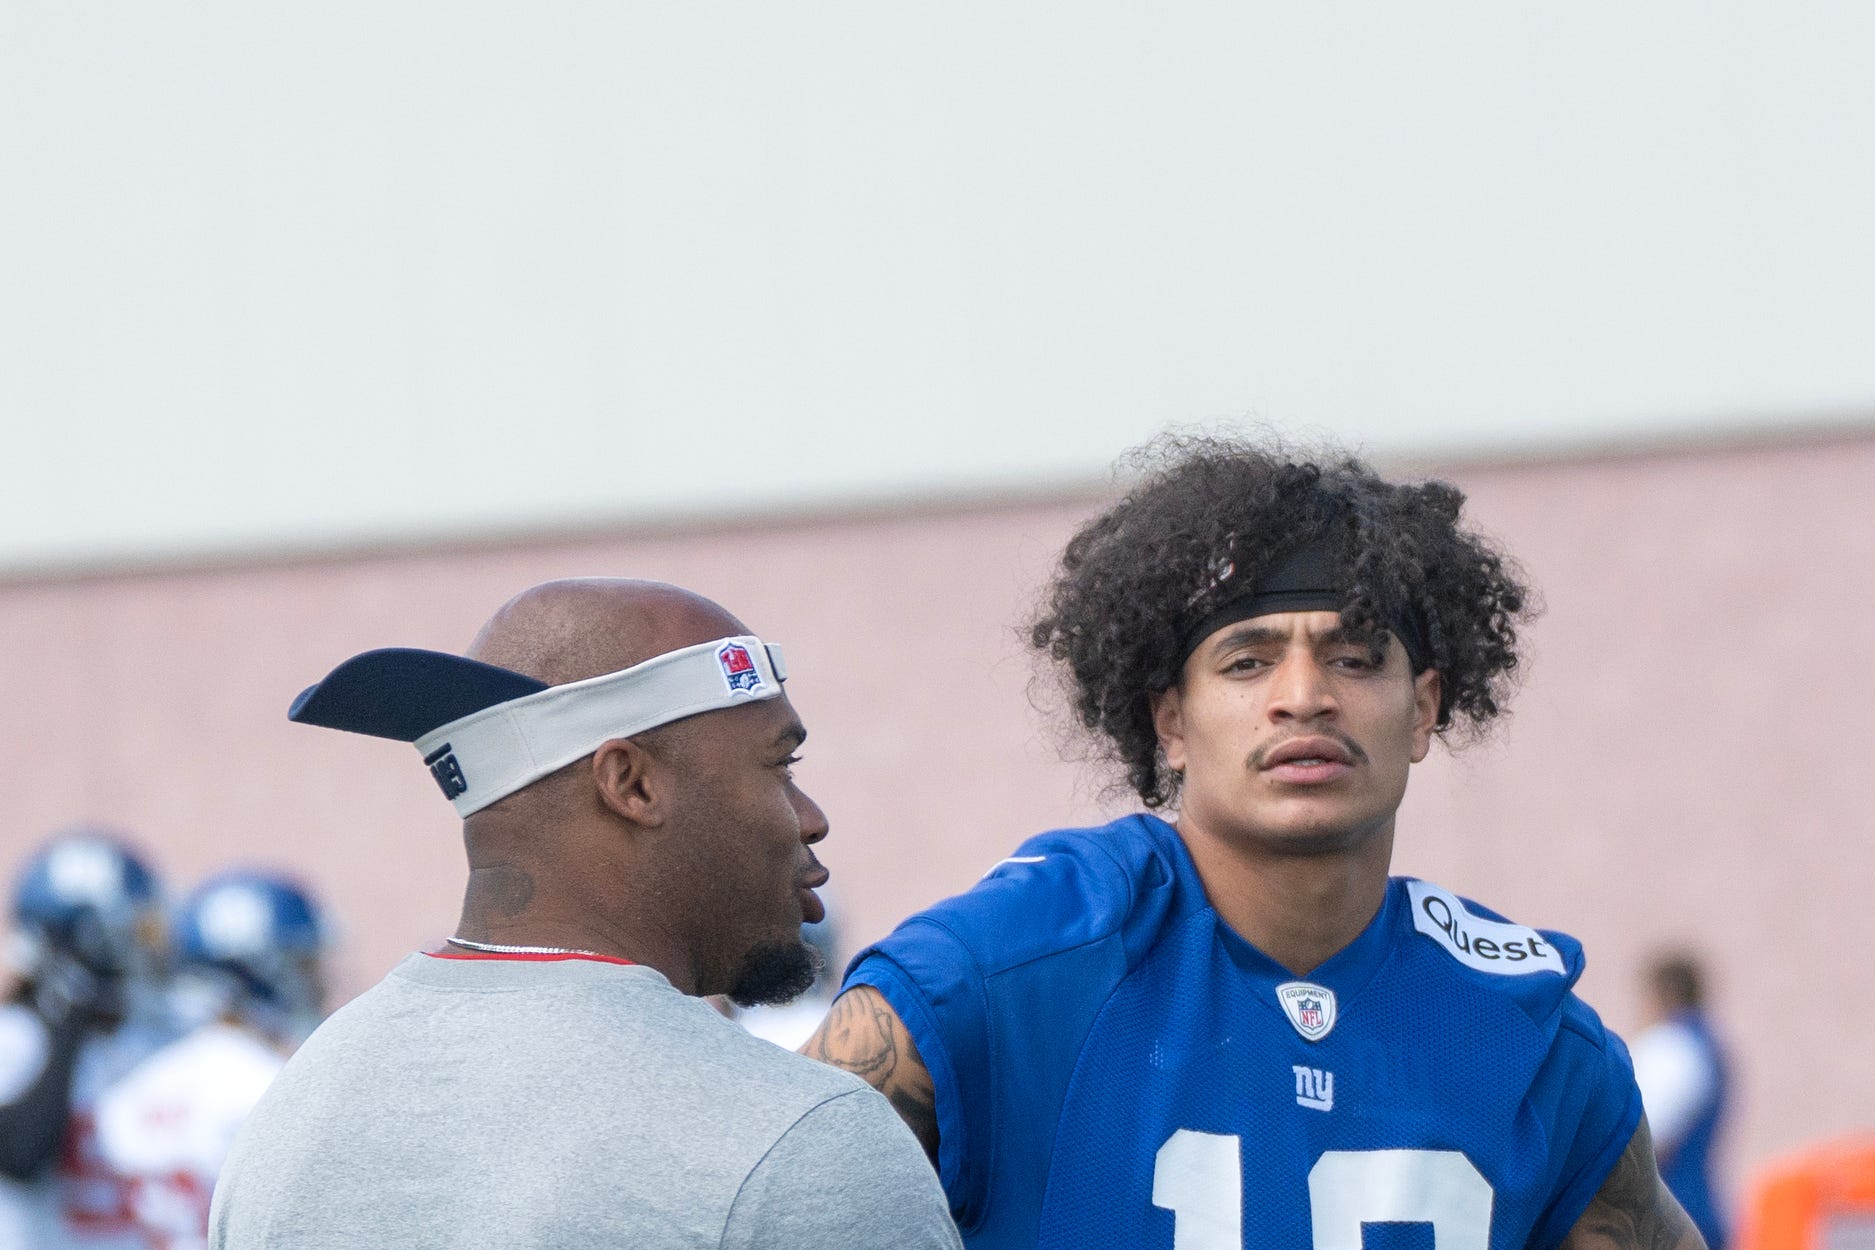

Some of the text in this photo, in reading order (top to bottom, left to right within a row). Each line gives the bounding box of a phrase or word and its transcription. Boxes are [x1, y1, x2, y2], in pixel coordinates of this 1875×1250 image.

[1422, 895, 1548, 962] Quest
[1285, 988, 1329, 1000] EQUIPMENT
[1301, 1010, 1322, 1027] NFL
